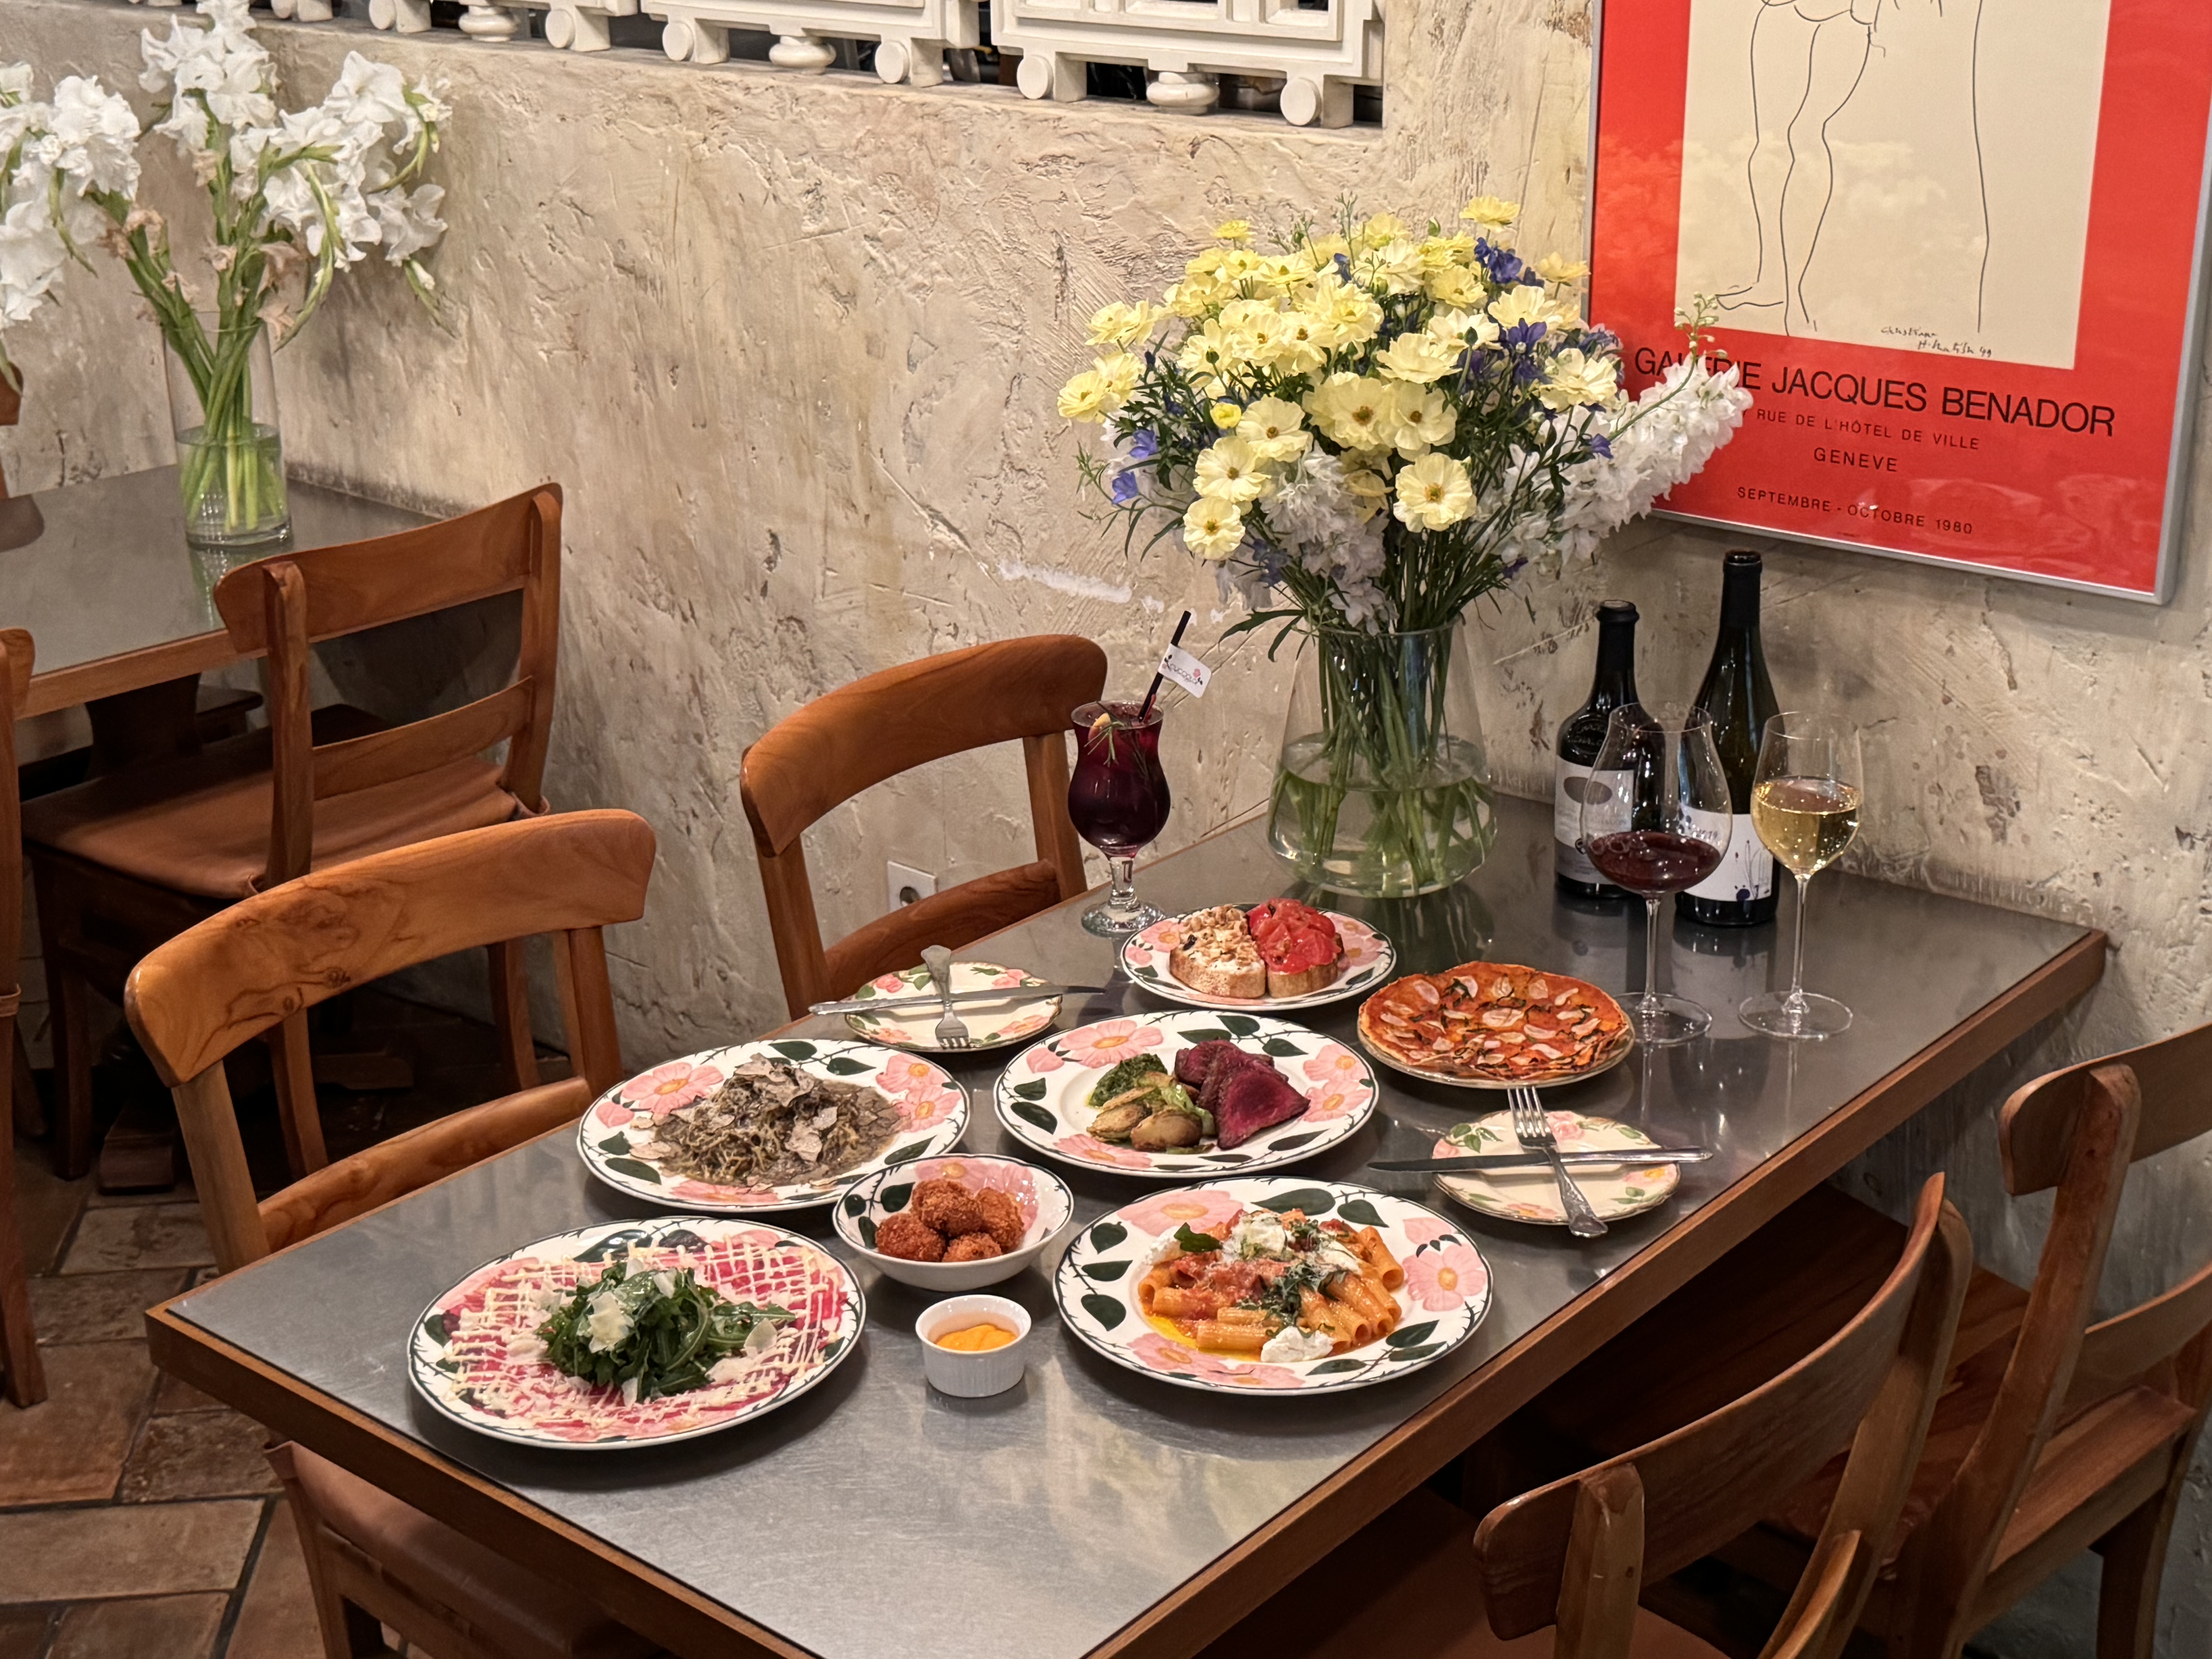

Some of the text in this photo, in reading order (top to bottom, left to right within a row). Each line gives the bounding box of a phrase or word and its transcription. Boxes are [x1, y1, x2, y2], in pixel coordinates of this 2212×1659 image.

[1771, 366, 1927, 412] JACQUES
[1942, 386, 2115, 437] BENADOR
[1757, 409, 1786, 423] RUE
[1796, 414, 1815, 427] DE
[1901, 429, 1922, 442] DE
[1933, 433, 1979, 450] VILLE
[1814, 447, 1898, 472] GENEVE
[1737, 486, 1831, 512] SEPTEMBRE
[1847, 504, 1925, 527] OCTOBRE
[1936, 519, 1973, 534] 1980
